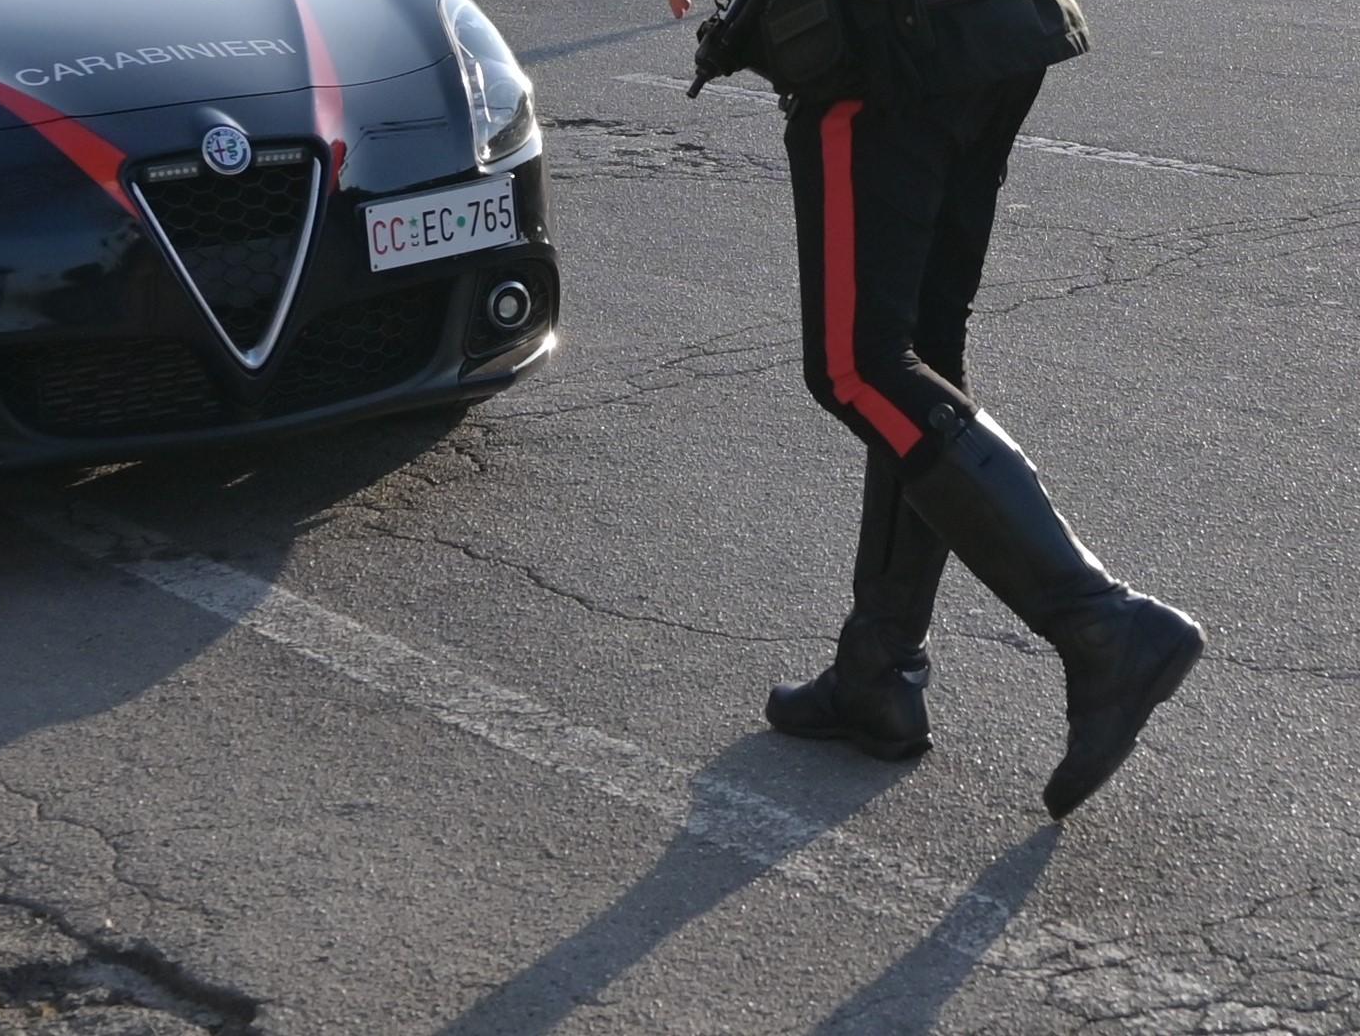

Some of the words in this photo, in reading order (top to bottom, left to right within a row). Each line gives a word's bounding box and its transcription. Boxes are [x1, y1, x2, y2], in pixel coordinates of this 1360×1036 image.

[15, 38, 297, 87] CARABINIERI
[372, 217, 406, 255] CC
[422, 207, 455, 246] EC
[467, 194, 512, 236] 765
